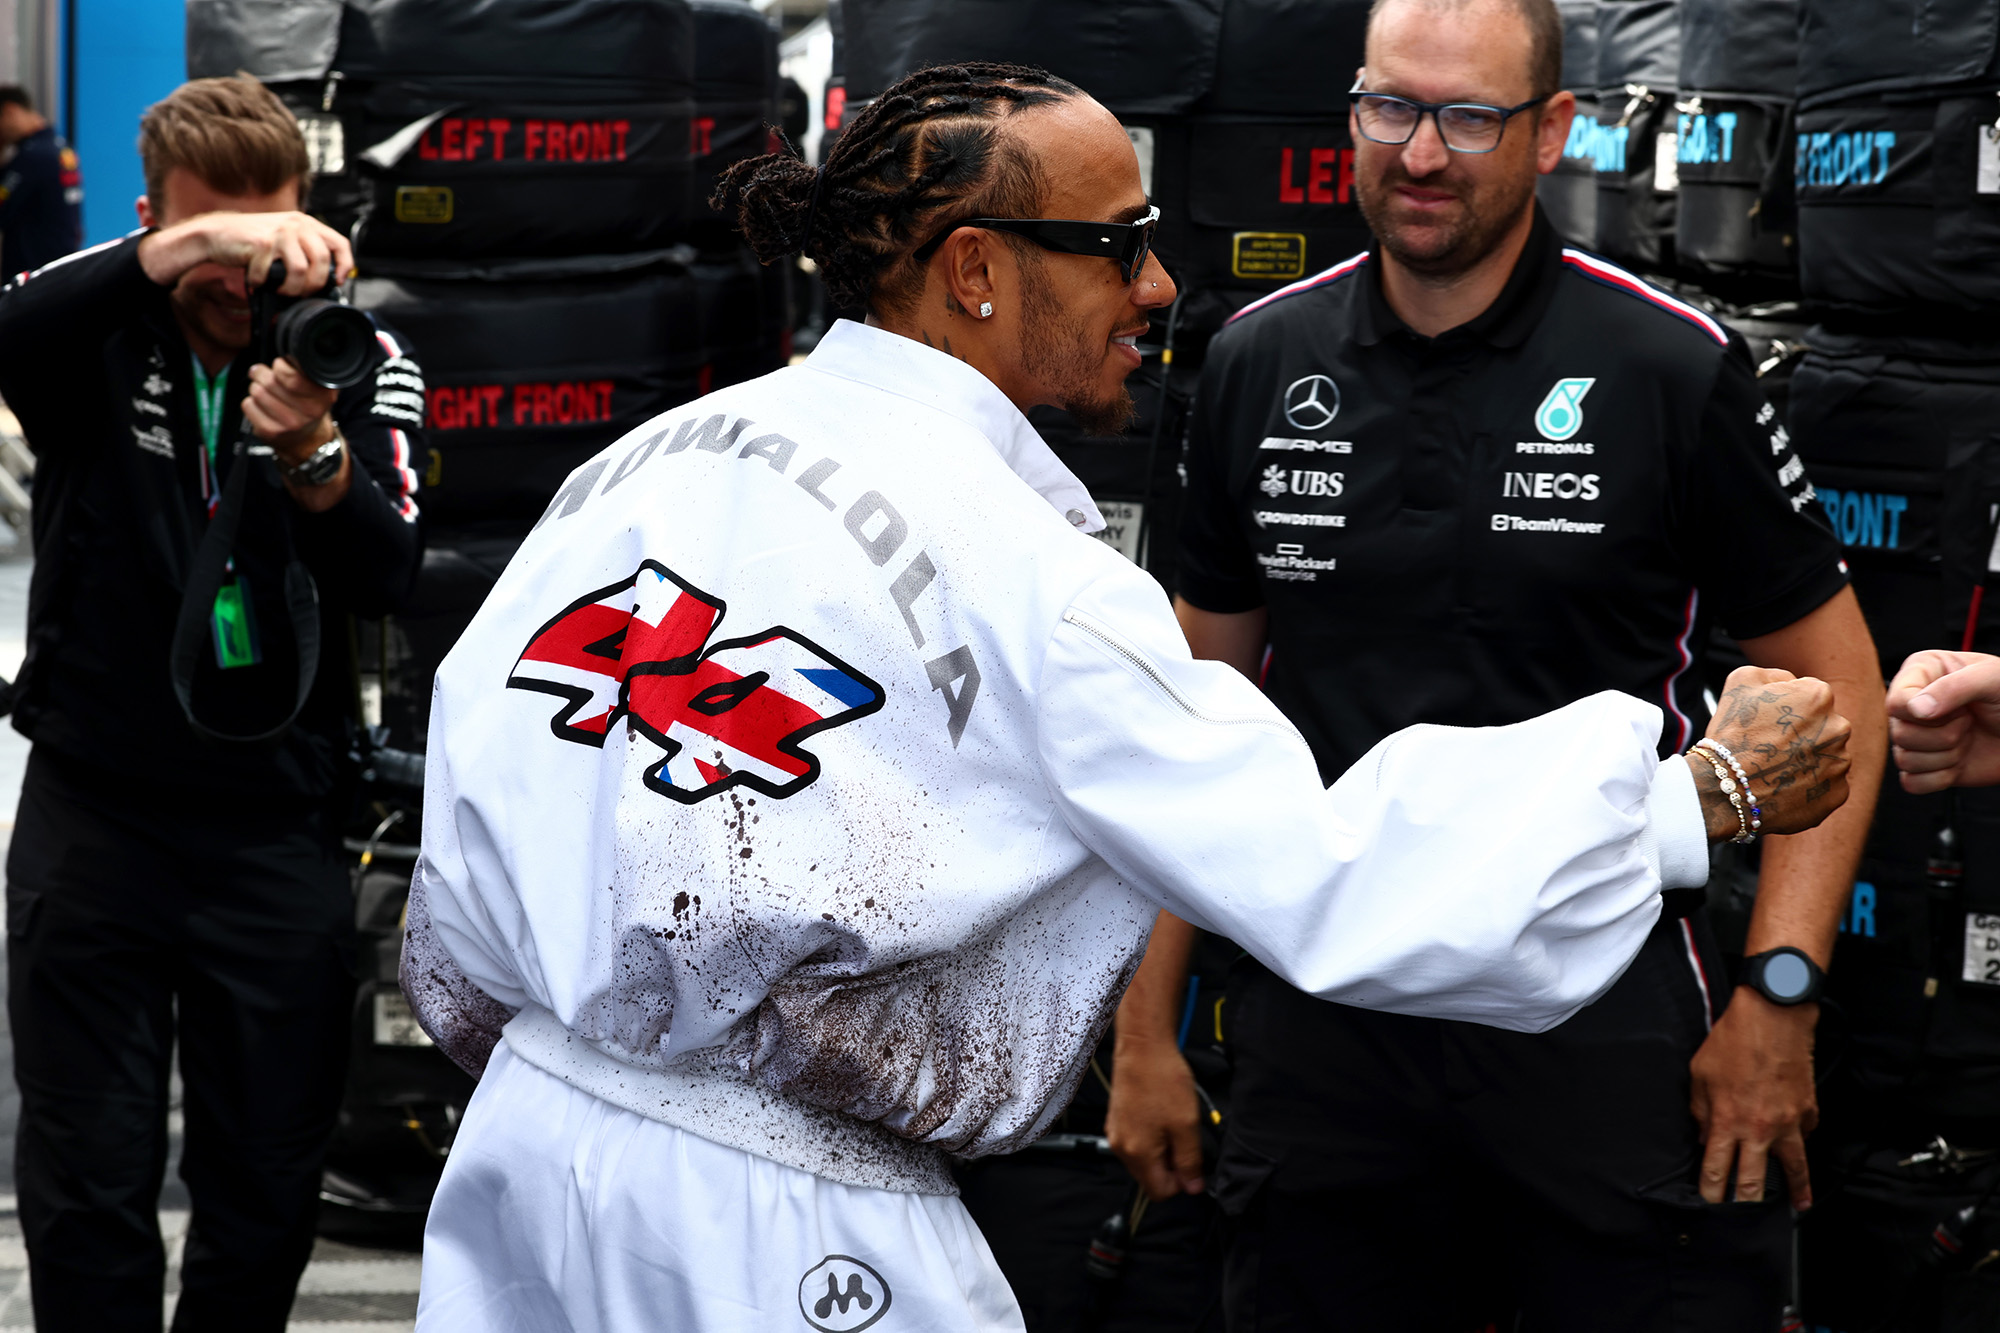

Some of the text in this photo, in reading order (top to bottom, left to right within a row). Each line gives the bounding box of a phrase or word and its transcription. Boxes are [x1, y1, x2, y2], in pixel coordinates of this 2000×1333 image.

[420, 117, 630, 162] LEFT FRONT
[424, 385, 504, 430] IGHT
[513, 381, 614, 427] FRONT
[1290, 439, 1353, 454] AMG
[1516, 442, 1595, 454] PETRONAS
[1291, 470, 1345, 497] UBS
[1502, 472, 1600, 500] INEOS
[1257, 511, 1346, 527] CROWDSTRIKE
[1510, 517, 1605, 533] TeamViewer
[1814, 486, 1908, 549] RONT
[1288, 556, 1336, 570] Packard
[1265, 567, 1317, 582] Enterprise
